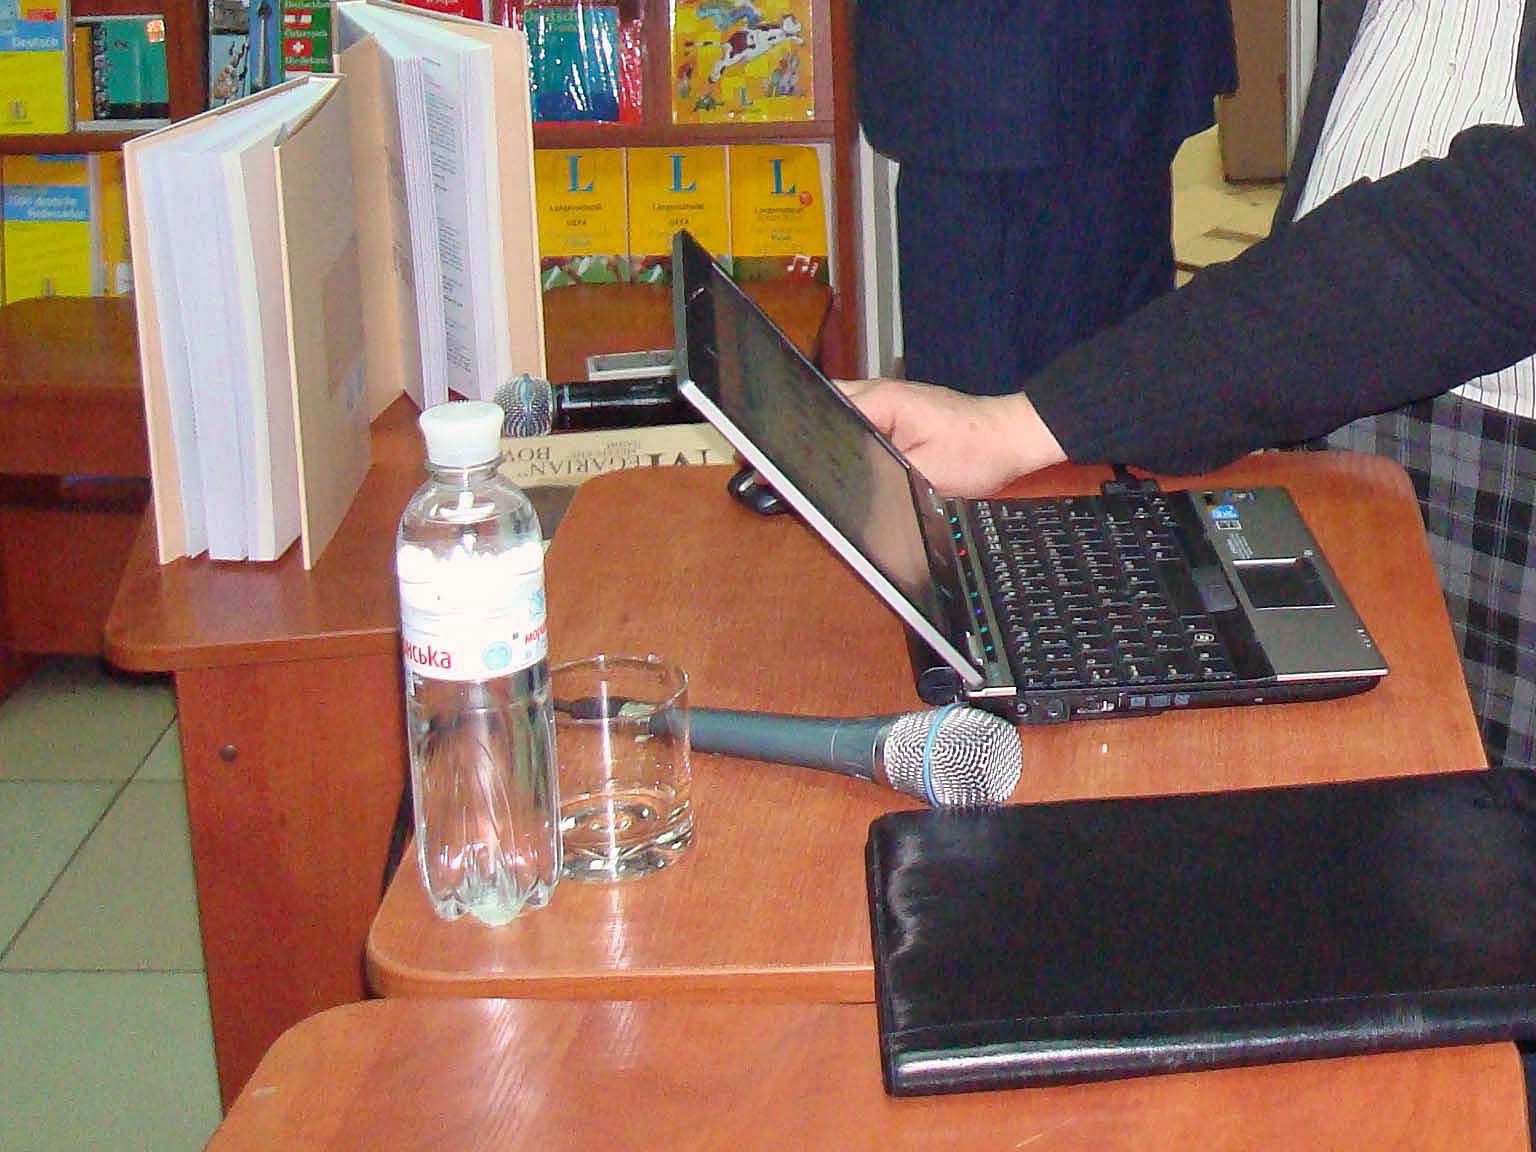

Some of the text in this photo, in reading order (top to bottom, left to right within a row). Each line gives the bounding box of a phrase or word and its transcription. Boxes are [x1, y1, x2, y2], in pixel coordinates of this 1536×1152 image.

[566, 154, 594, 193] L
[666, 153, 697, 193] L
[769, 158, 797, 195] L
